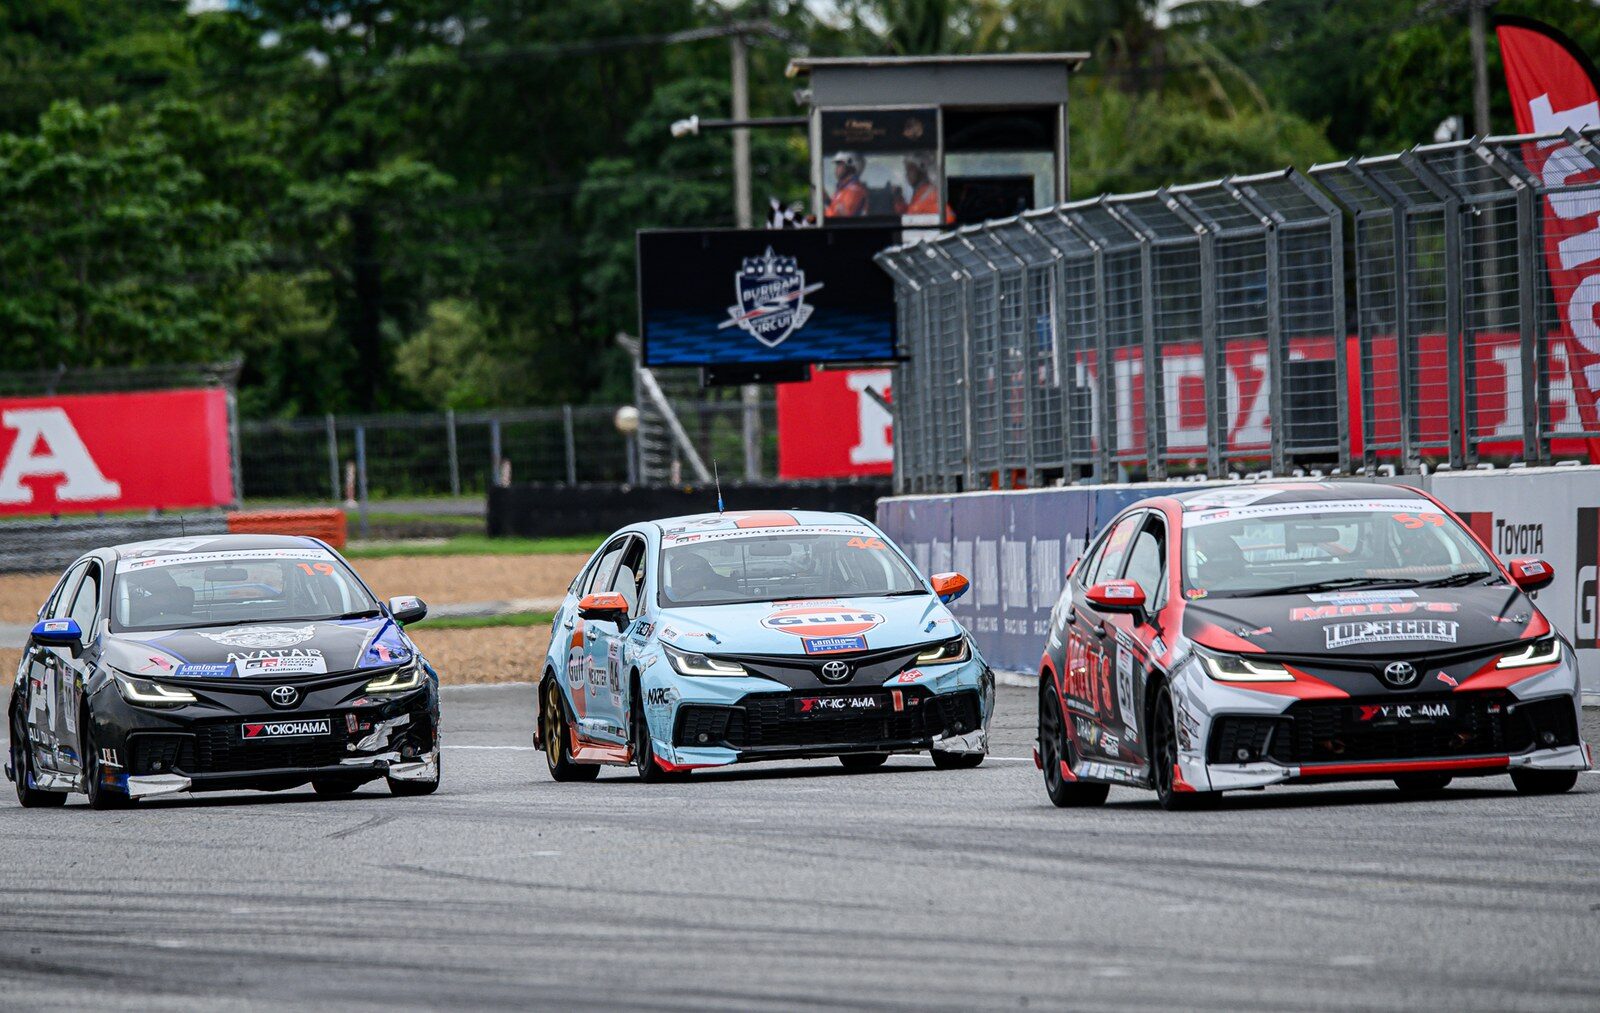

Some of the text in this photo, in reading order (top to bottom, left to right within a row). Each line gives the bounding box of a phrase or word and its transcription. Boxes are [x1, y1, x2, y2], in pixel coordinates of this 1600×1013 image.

[1393, 512, 1446, 530] 59
[704, 529, 761, 539] TOYOTA
[818, 527, 864, 535] Racing
[847, 537, 886, 550] 46
[297, 563, 335, 577] 19
[768, 613, 876, 626] Gulf
[1323, 619, 1459, 641] TOP SECRET
[568, 653, 584, 682] Gulf
[264, 721, 329, 736] YOKOHAMA
